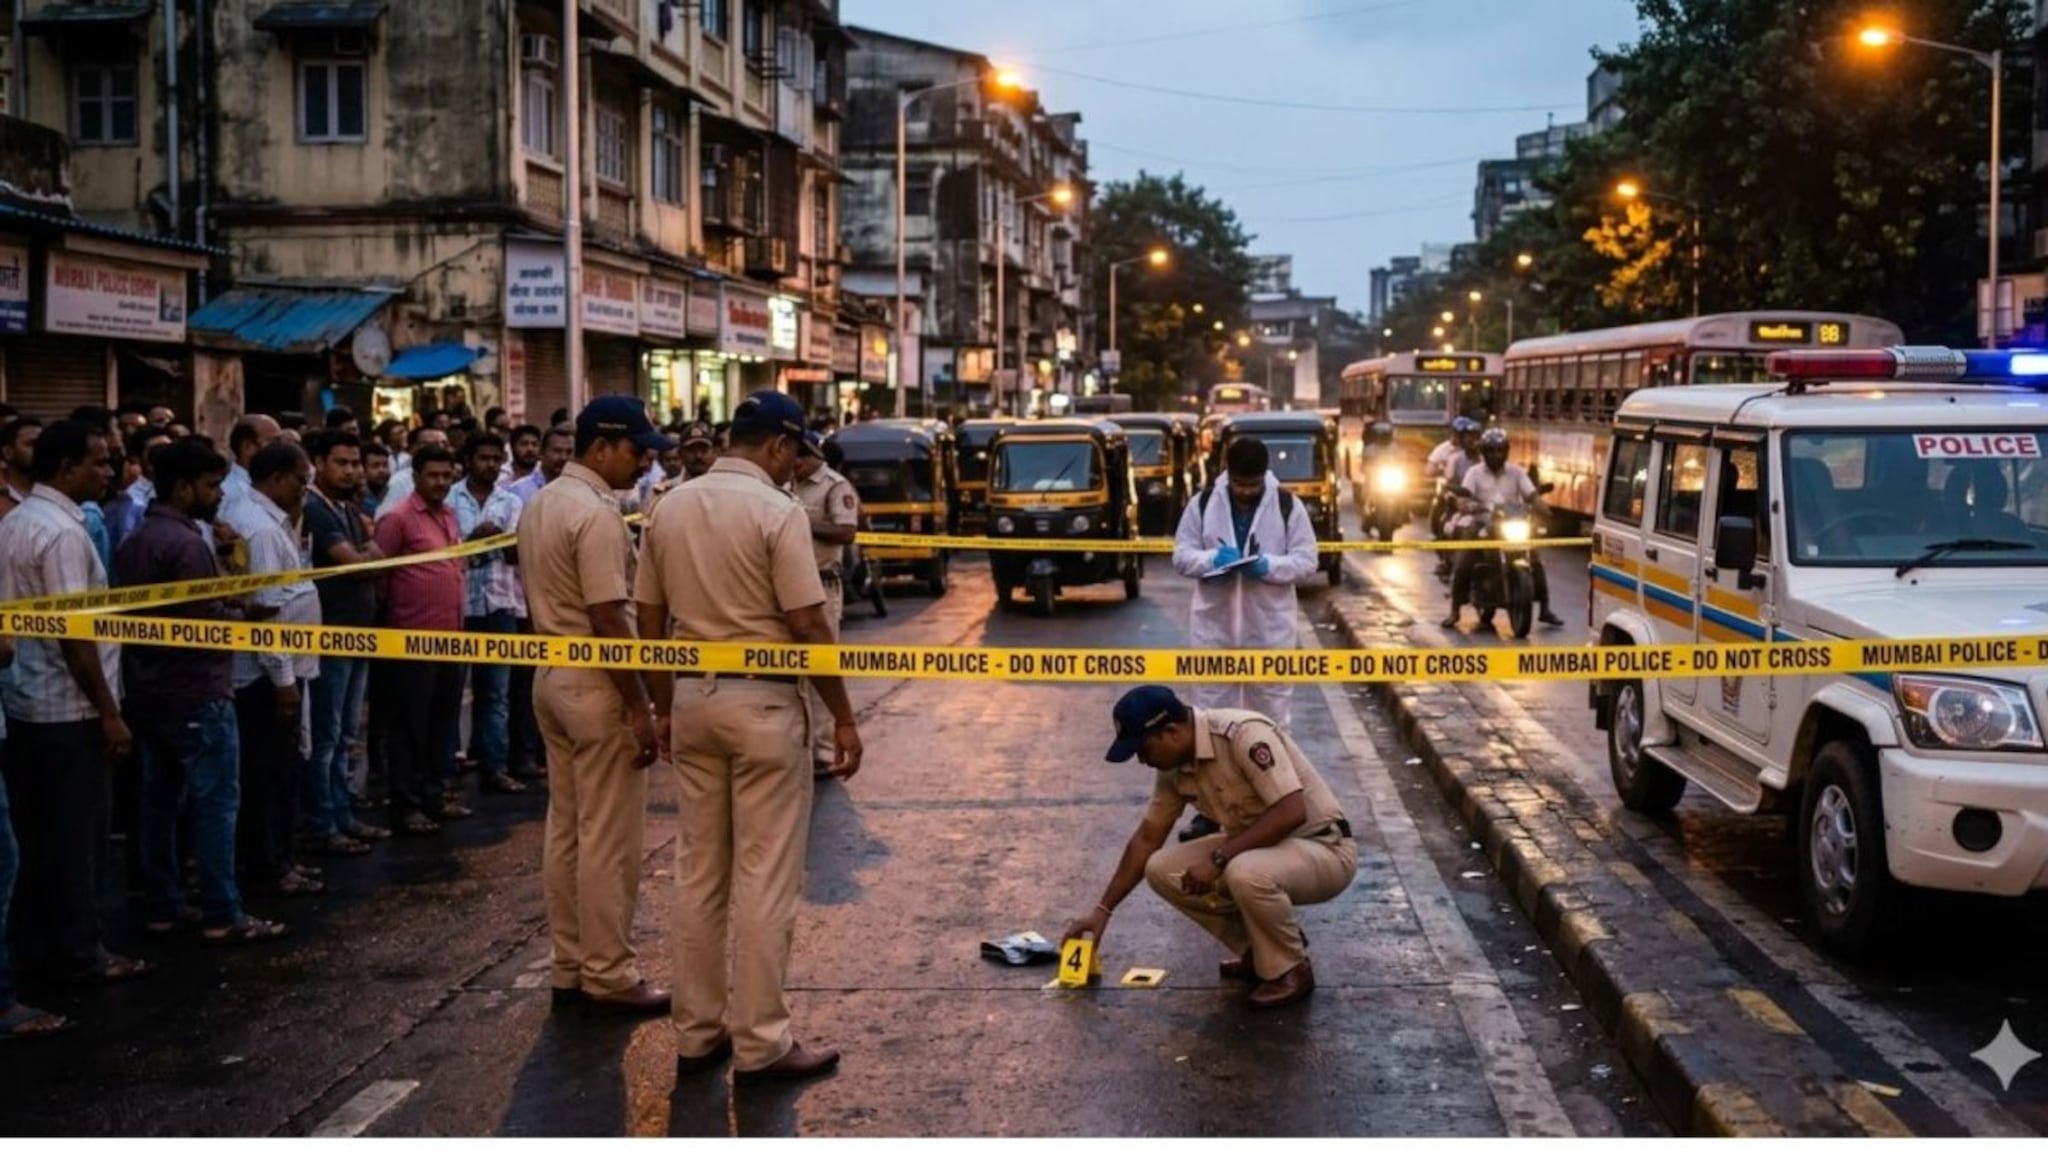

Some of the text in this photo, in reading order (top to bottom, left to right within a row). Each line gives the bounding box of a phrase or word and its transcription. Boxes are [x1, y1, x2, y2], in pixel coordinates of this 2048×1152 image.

[1918, 436, 2037, 455] POLICE
[12, 614, 68, 634] CROSS
[93, 618, 165, 640] MUMBAI
[171, 623, 232, 645] POLICE
[250, 627, 274, 646] DO
[280, 629, 314, 649] NOT
[319, 631, 378, 652] CROSS
[405, 635, 479, 657] MUMBAI
[485, 639, 549, 660] POLICE
[568, 643, 593, 662] DO
[599, 644, 634, 664] NOT
[639, 645, 700, 666] CROSS
[744, 648, 809, 669] POLICE
[839, 650, 916, 671] MUMBAI
[923, 654, 988, 673] POLICE
[1009, 655, 1035, 674] DO
[1041, 655, 1077, 675] NOT
[1084, 655, 1146, 675] CROSS
[1518, 652, 1598, 674] MUMBAI
[1604, 650, 1672, 672] POLICE
[1692, 649, 1718, 670] DO
[1725, 648, 1762, 670] NOT
[1767, 646, 1831, 669] CROSS
[1861, 642, 1943, 666] MUMBAI
[1949, 640, 2018, 663] POLICE
[1176, 655, 1255, 676] MUMBAI
[1262, 655, 1329, 676] POLICE
[1350, 655, 1375, 675] DO
[1382, 655, 1419, 676] NOT
[1425, 653, 1488, 675] CROSS
[1067, 946, 1083, 972] 4
